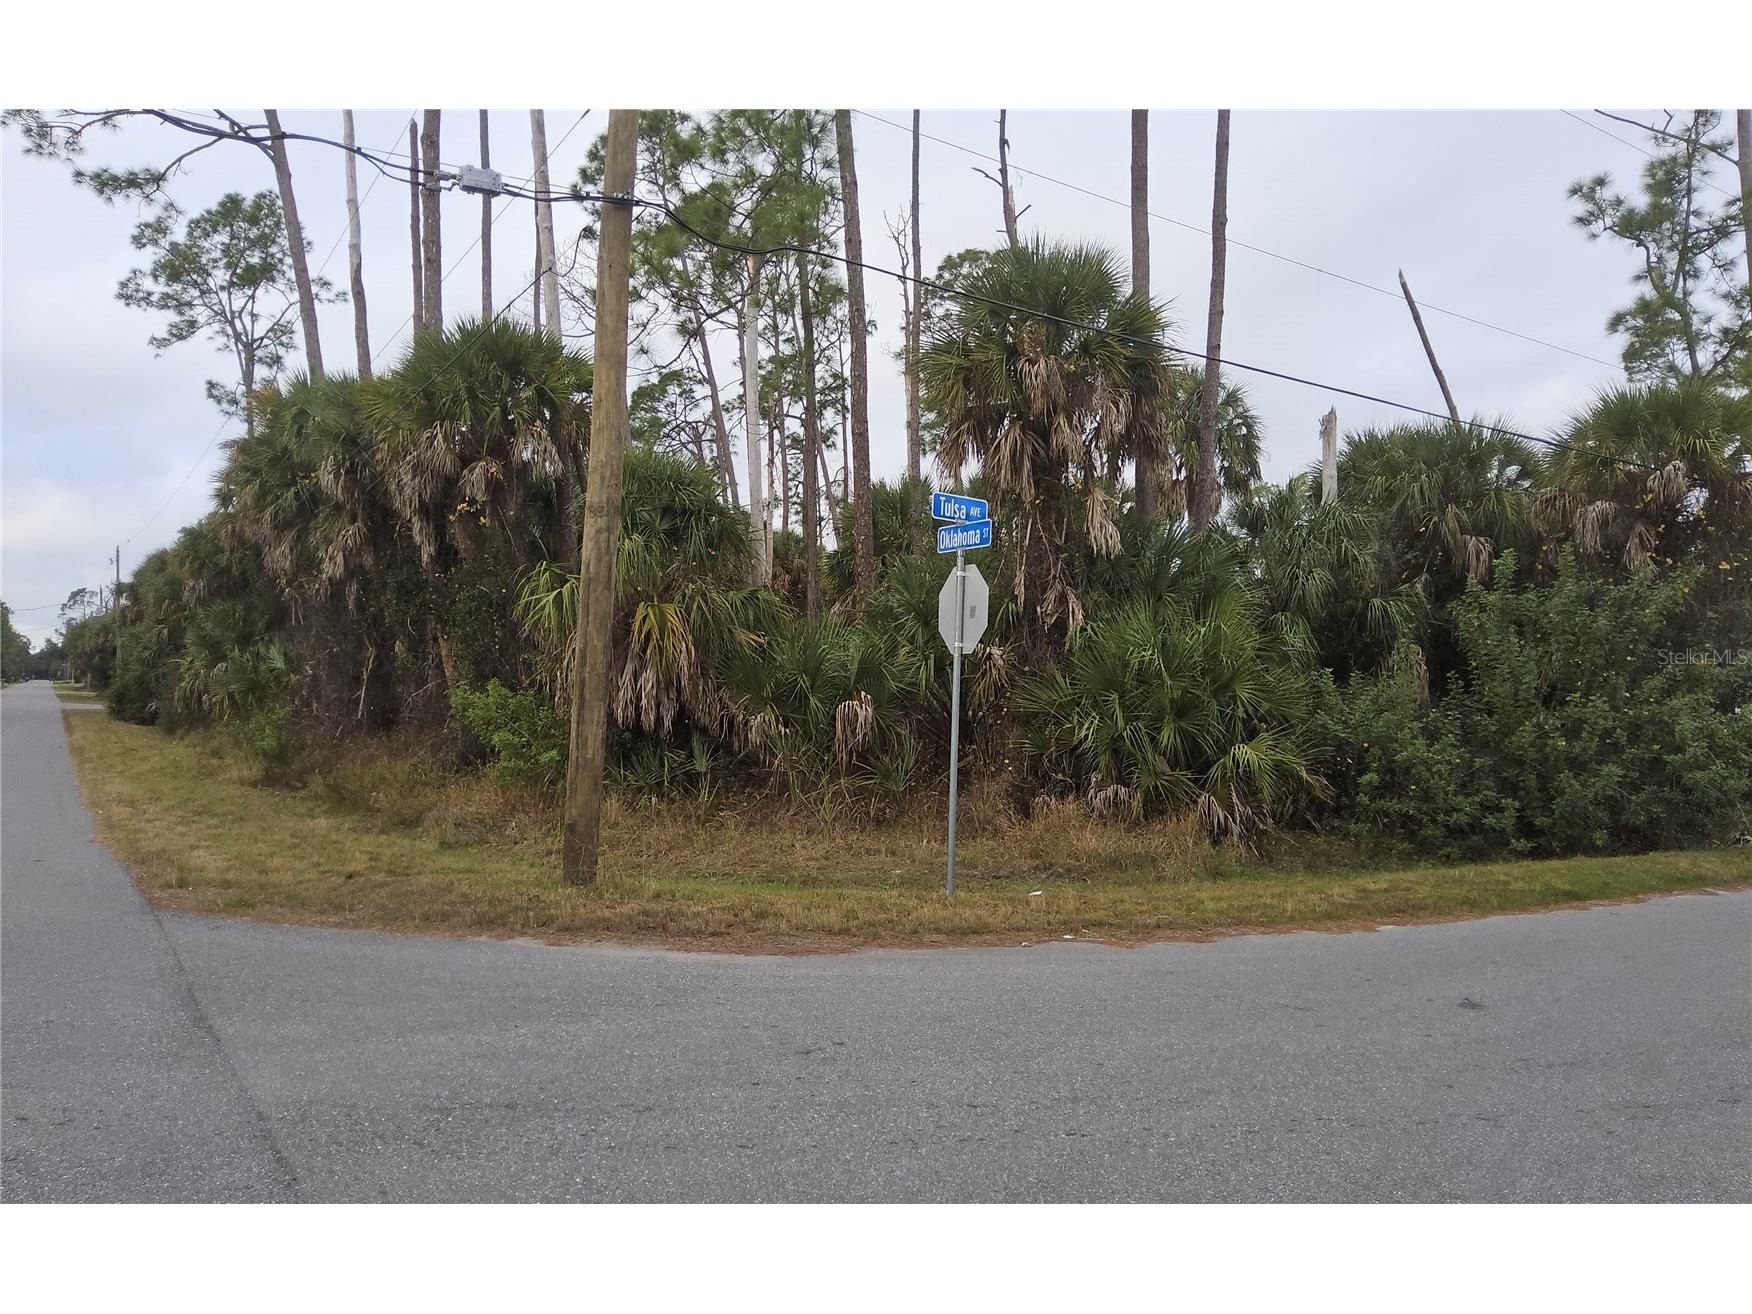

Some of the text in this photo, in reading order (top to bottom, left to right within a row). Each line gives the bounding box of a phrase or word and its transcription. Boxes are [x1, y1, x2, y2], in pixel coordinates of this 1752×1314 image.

[940, 496, 982, 519] Tulsa AVE
[940, 527, 989, 549] Oklahoma ST
